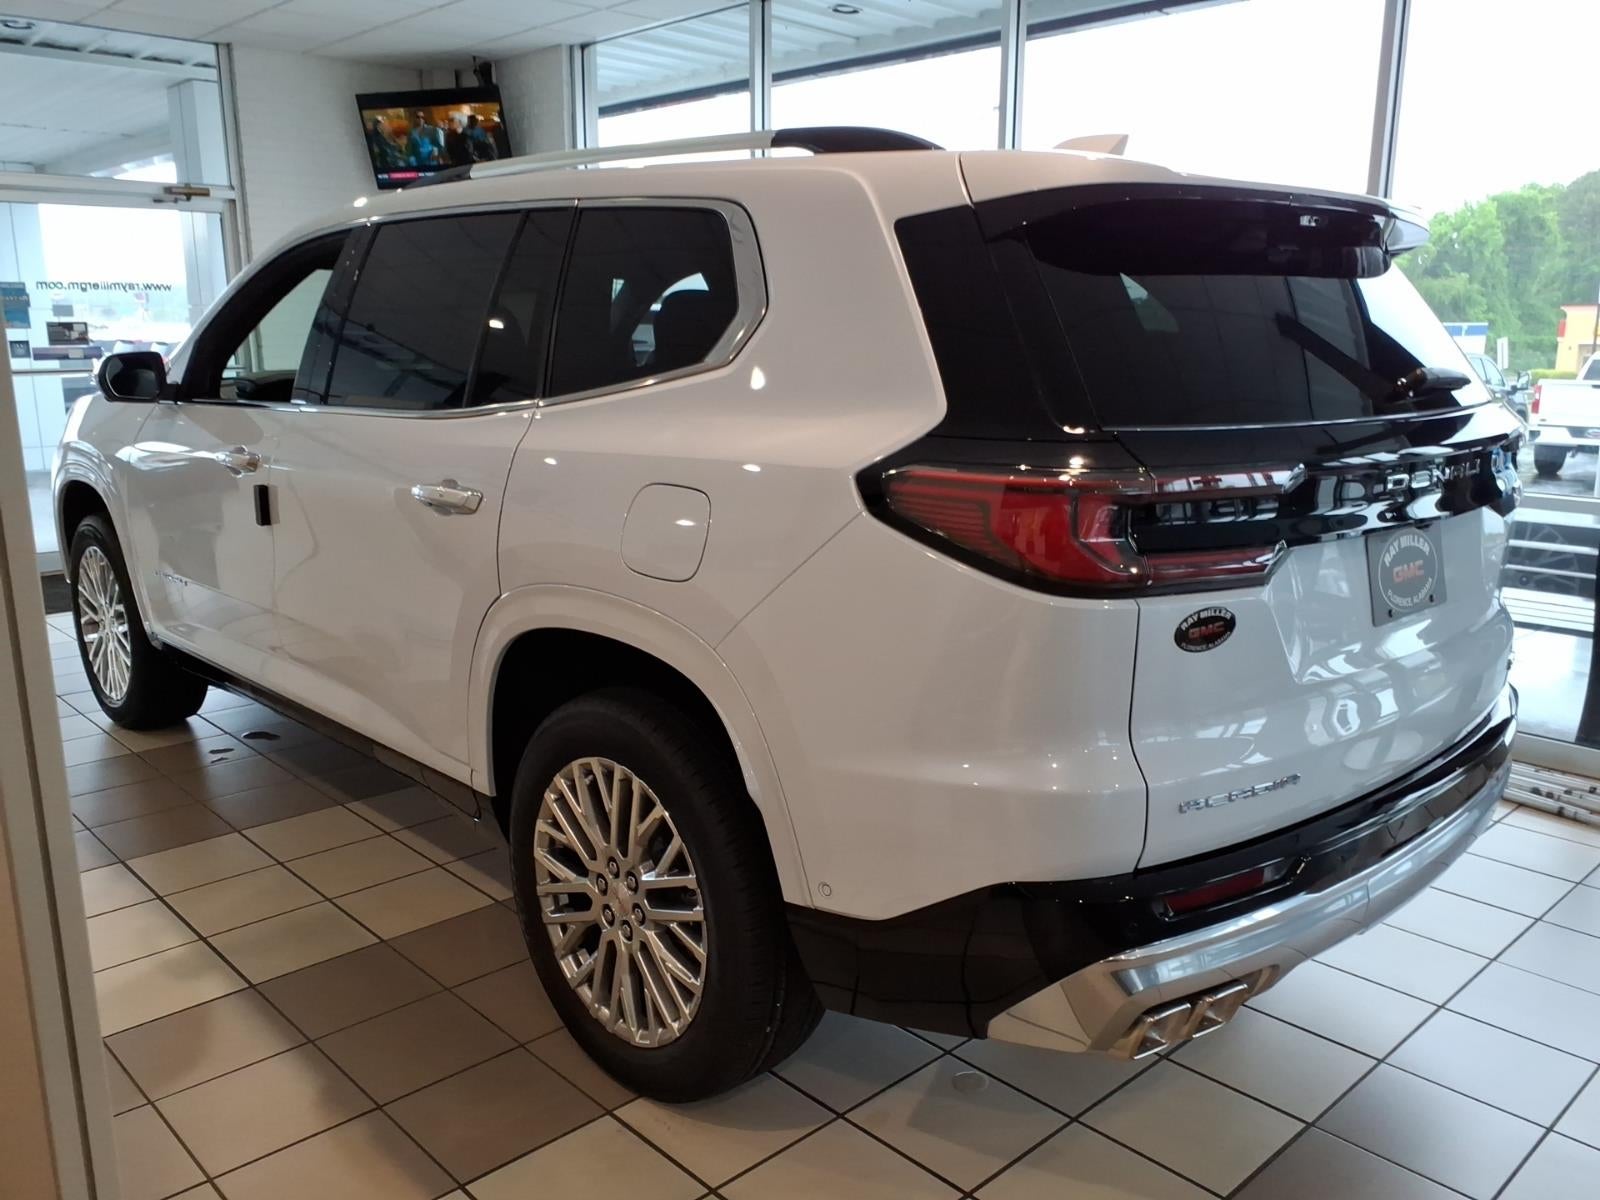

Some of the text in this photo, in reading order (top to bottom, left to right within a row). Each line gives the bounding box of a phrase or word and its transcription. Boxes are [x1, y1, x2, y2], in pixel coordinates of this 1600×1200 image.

[1384, 535, 1430, 567] RAY MILLER
[1392, 560, 1424, 583] GMC
[1181, 608, 1232, 631] RAY MILLER
[1188, 621, 1225, 639] GMC
